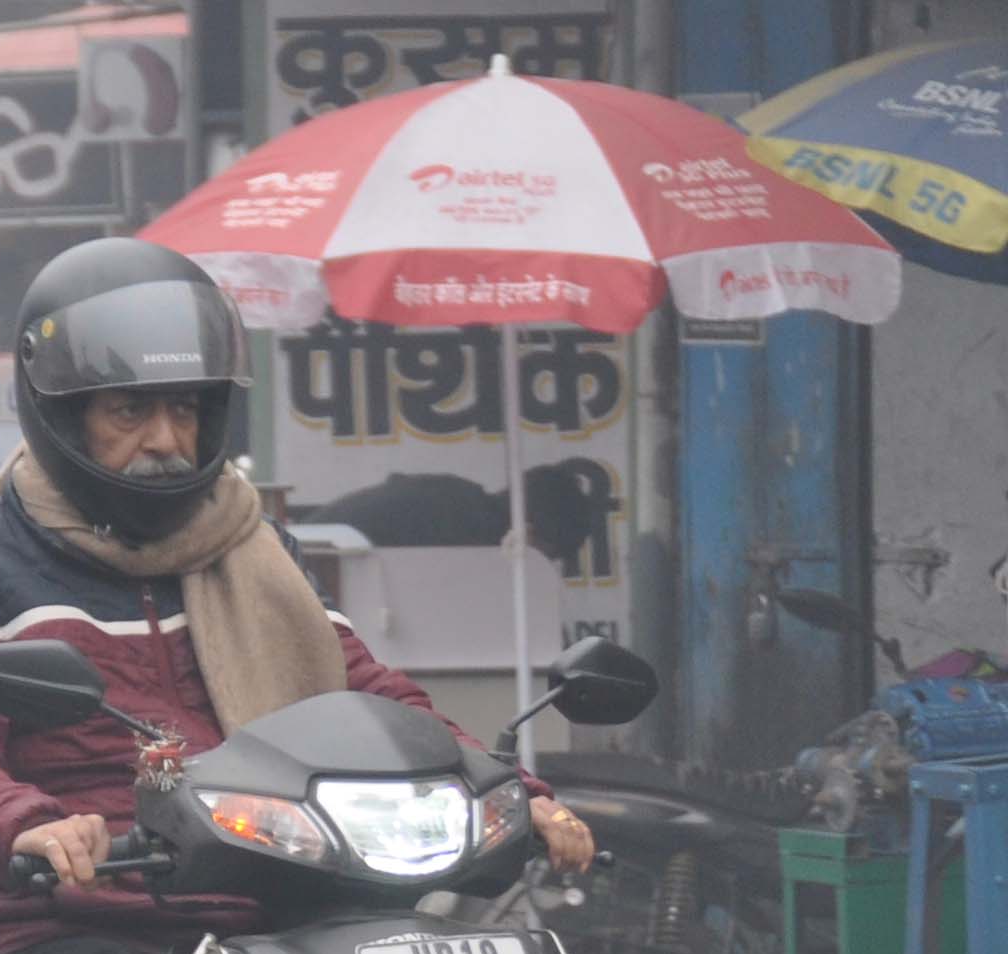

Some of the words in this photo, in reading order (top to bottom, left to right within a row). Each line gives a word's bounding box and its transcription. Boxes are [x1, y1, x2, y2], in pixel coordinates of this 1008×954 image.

[913, 80, 1002, 113] BSNL
[784, 146, 899, 199] BSNL
[908, 179, 967, 225] 5G
[143, 353, 201, 364] HONDA
